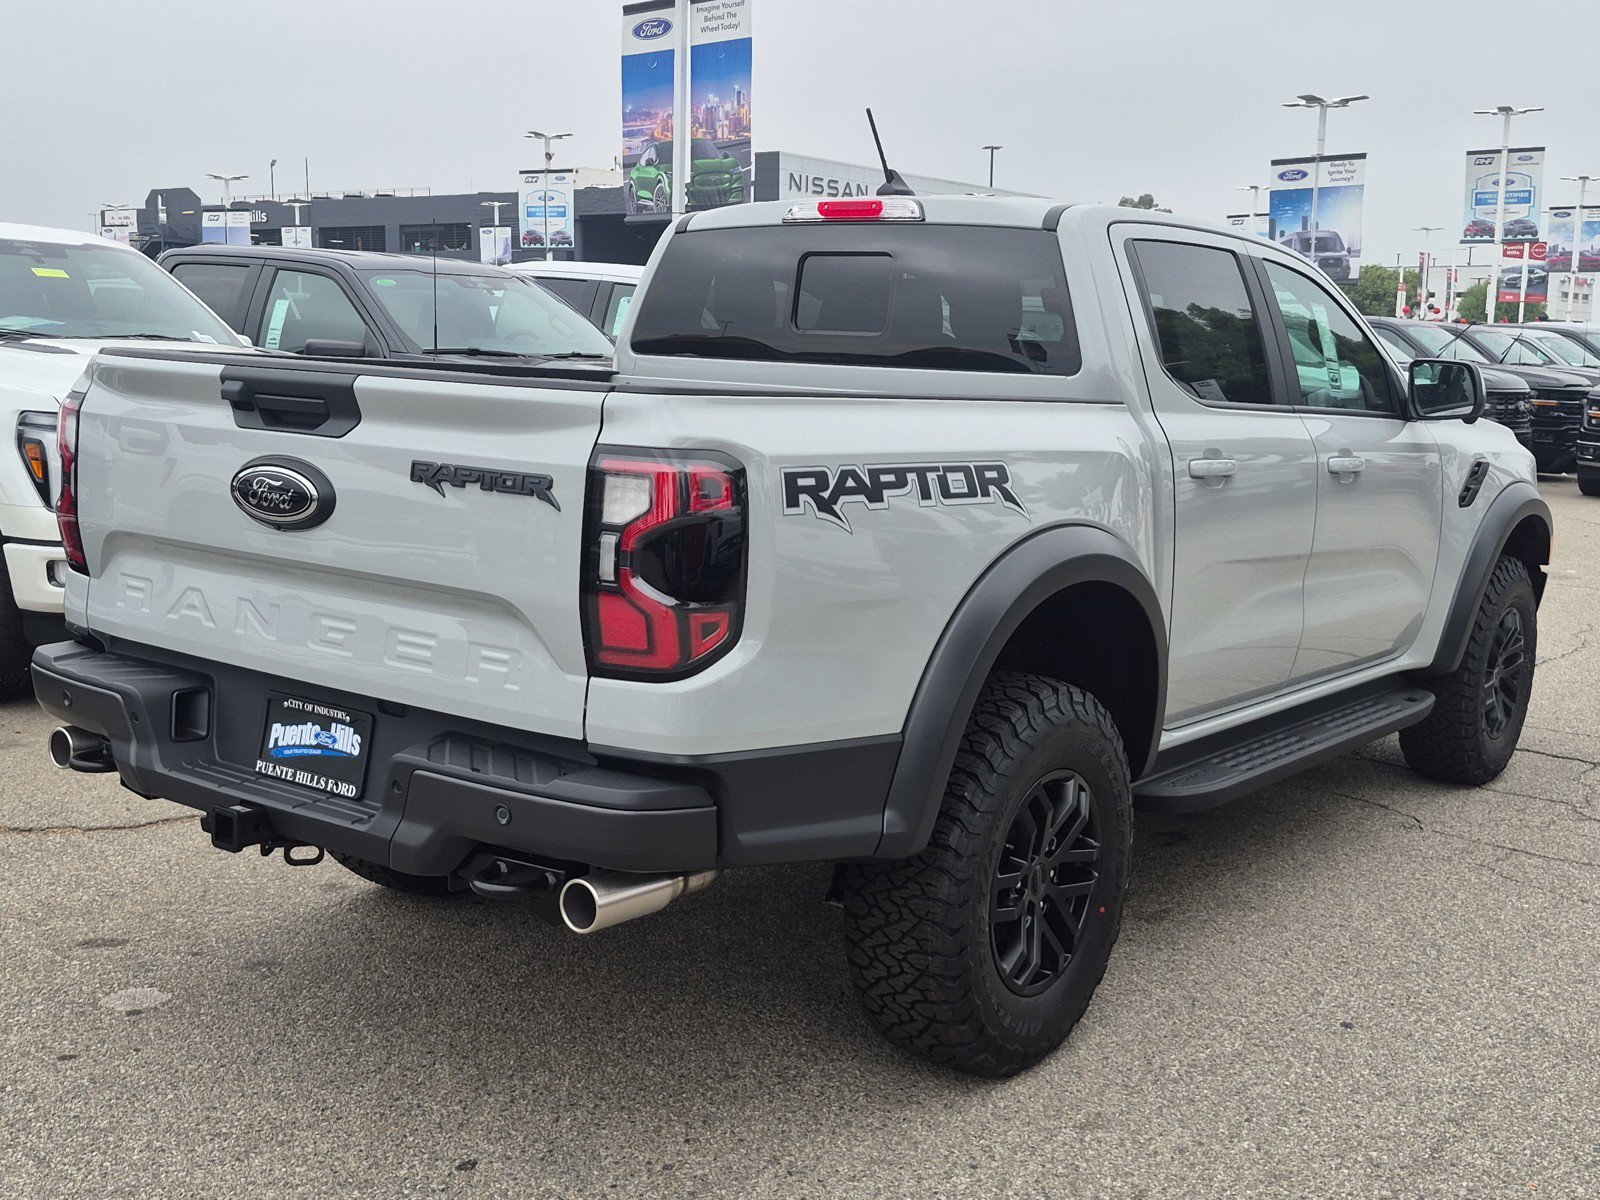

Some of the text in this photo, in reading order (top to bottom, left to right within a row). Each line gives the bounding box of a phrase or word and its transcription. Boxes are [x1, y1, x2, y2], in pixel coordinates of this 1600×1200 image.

[696, 0, 745, 13] Imagine Yourself
[703, 11, 737, 22] Behind The
[638, 20, 666, 38] Ford
[700, 21, 741, 33] Wheel Today!
[788, 172, 869, 198] NISSAN
[1329, 175, 1355, 183] Journey?
[248, 476, 294, 510] Ford
[410, 459, 562, 512] RAPTOR
[779, 460, 1032, 535] RAPTOR
[115, 572, 524, 691] RANGER
[288, 699, 347, 720] CITY OF INDUSTRY
[268, 721, 362, 757] Puente Ford Hills
[255, 760, 357, 798] PUENTE HILLS FORD
